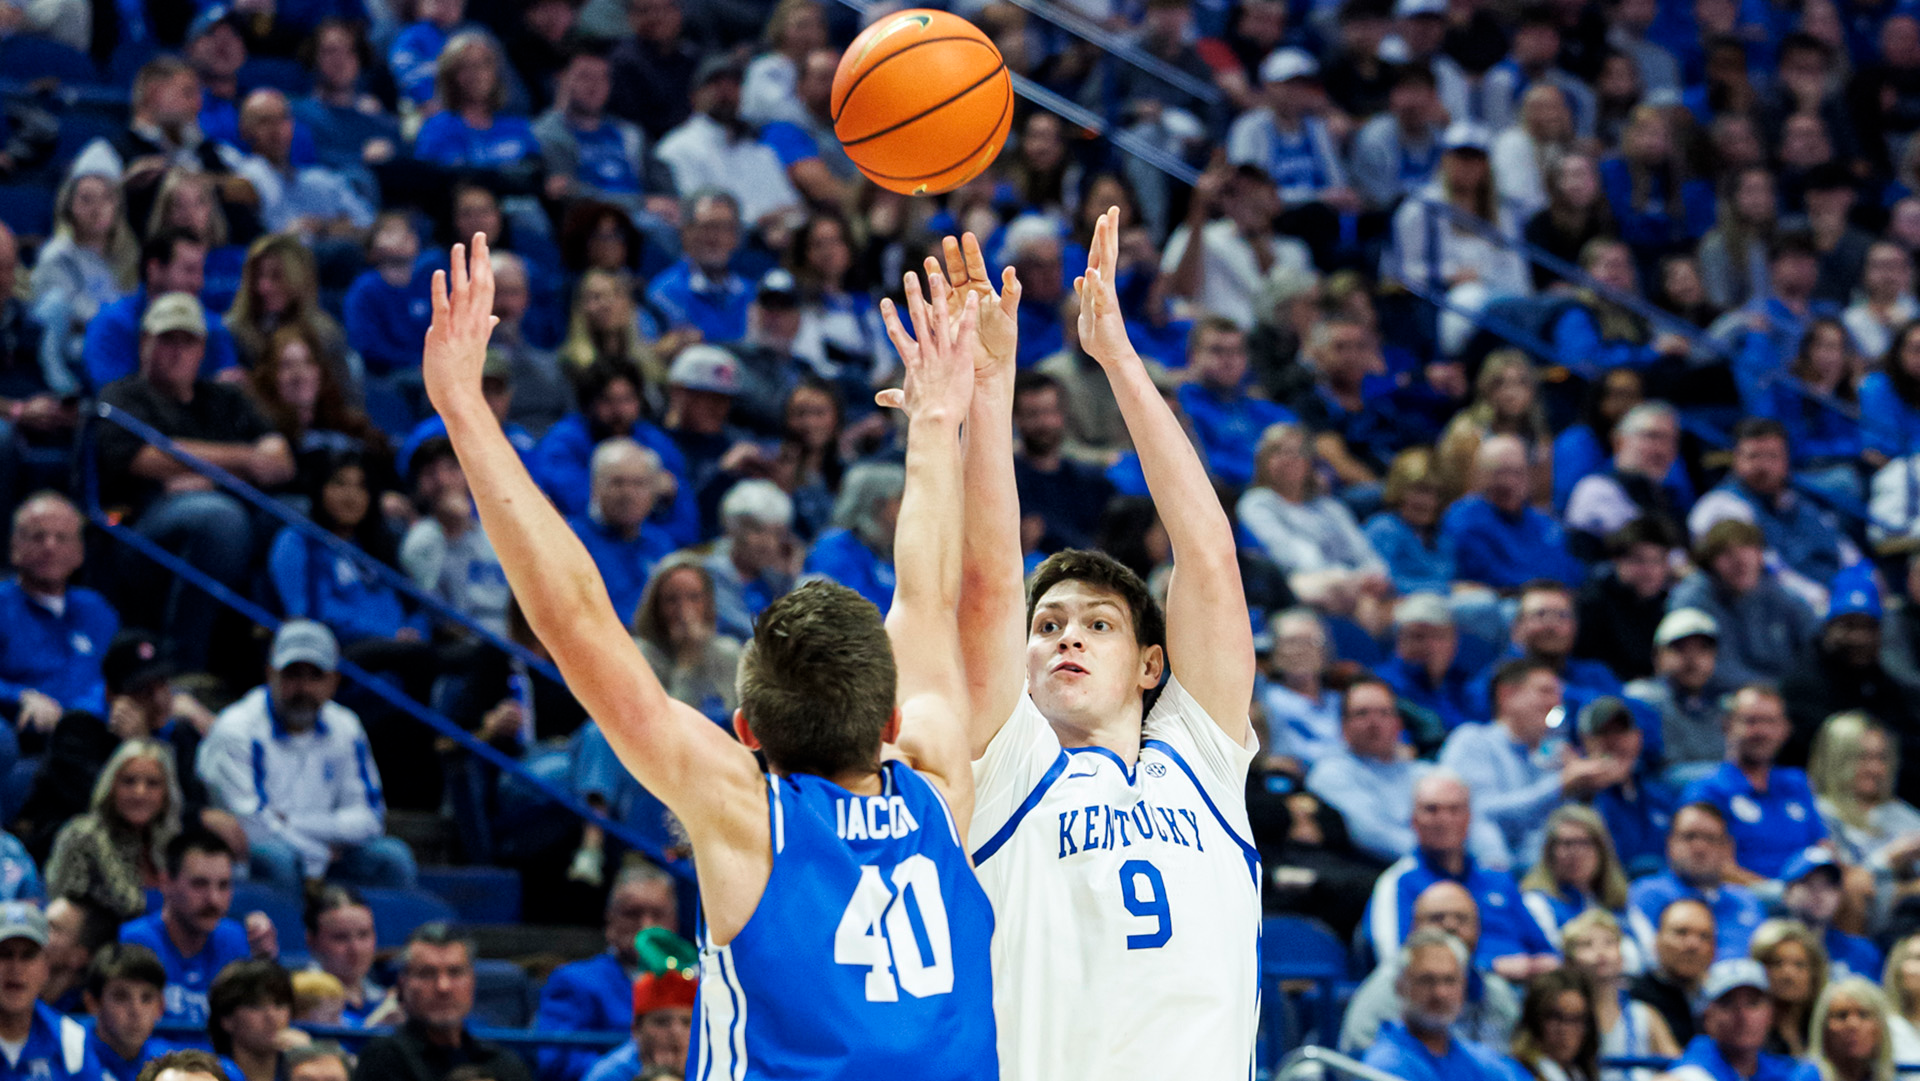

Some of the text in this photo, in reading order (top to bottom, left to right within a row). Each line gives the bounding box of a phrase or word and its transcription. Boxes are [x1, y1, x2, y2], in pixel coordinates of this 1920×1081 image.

[1058, 800, 1204, 859] KENTUCKY
[834, 853, 955, 1002] 40
[1119, 860, 1173, 950] 9
